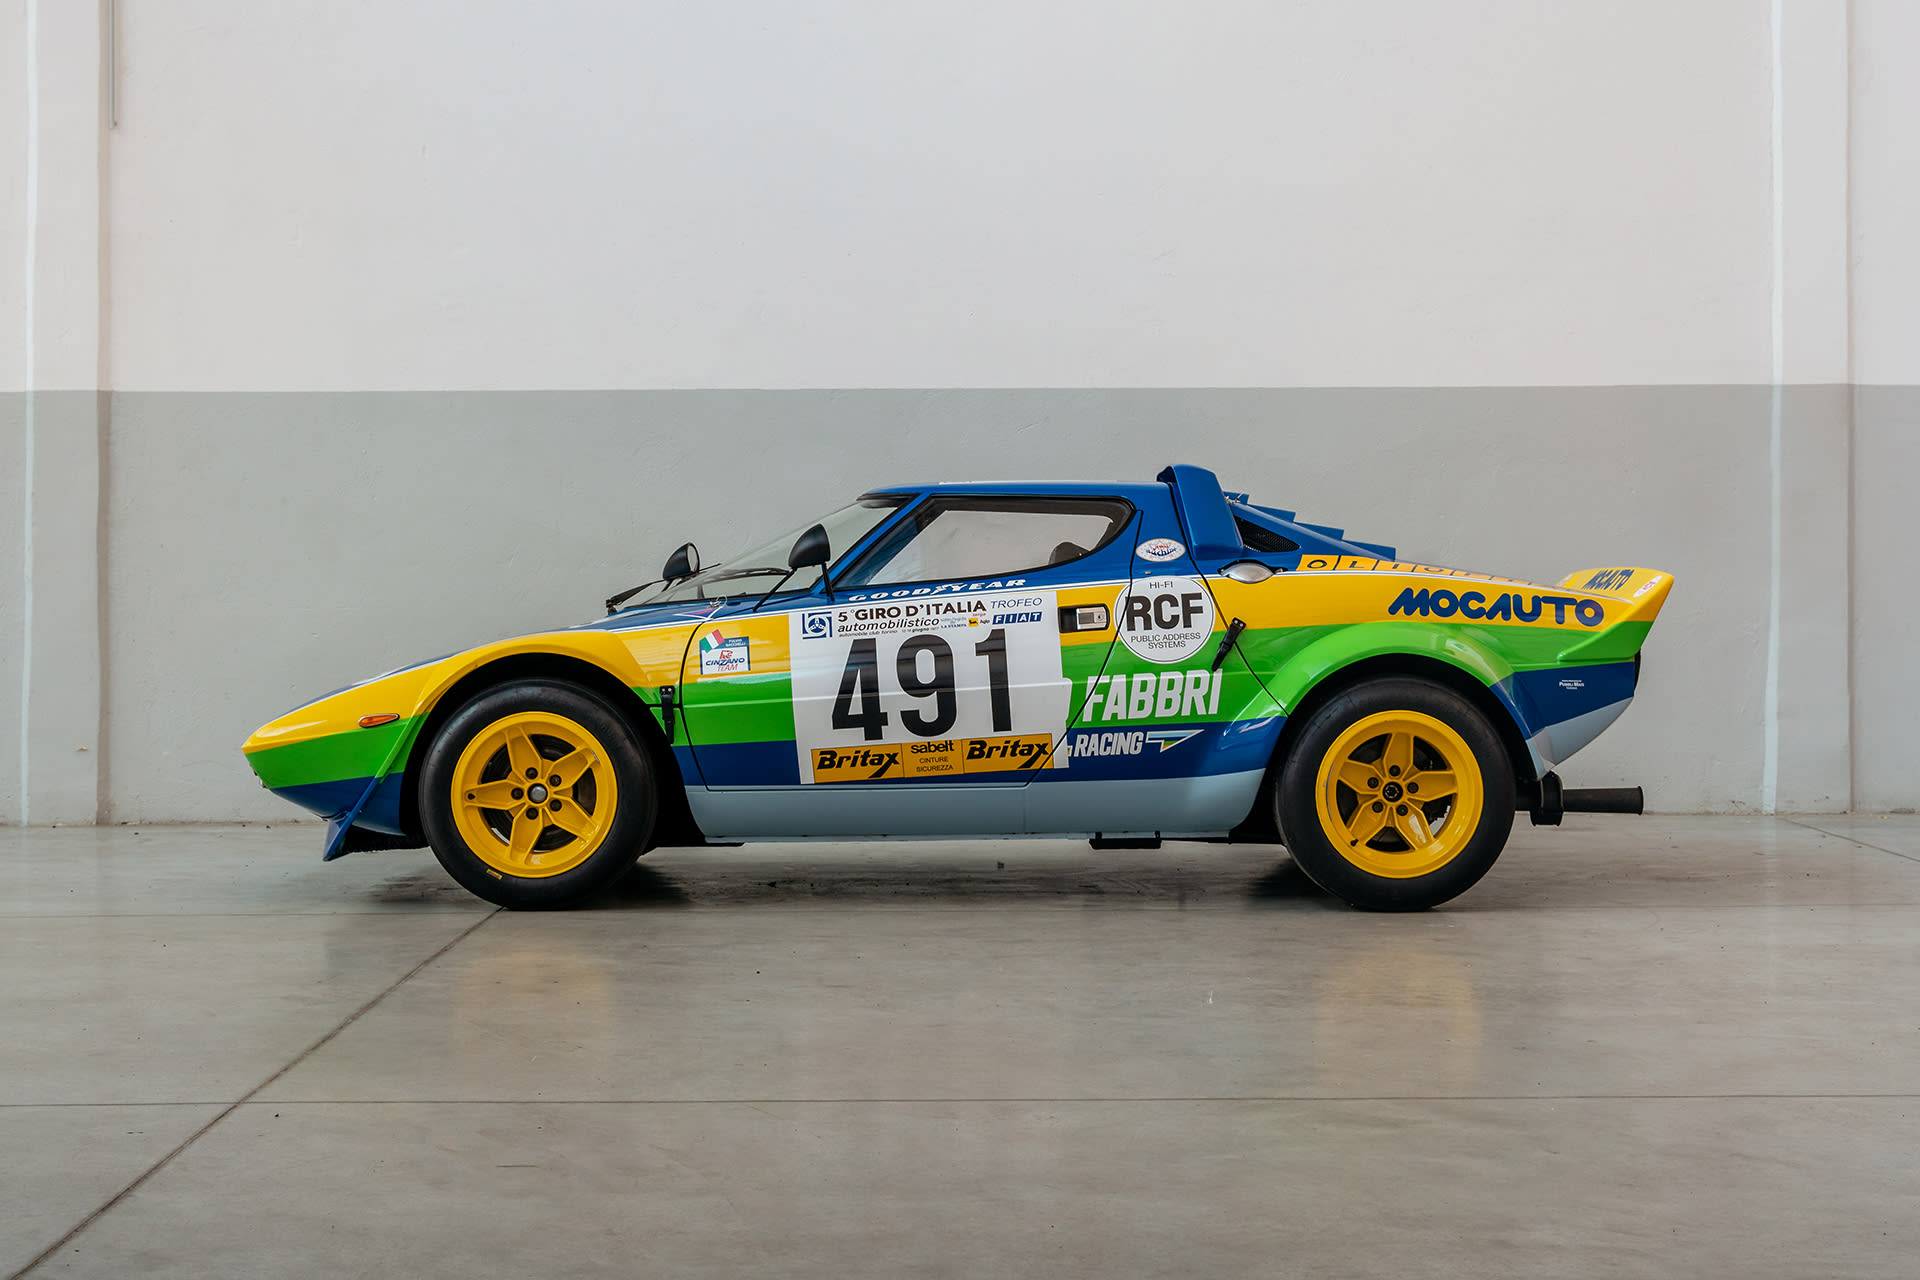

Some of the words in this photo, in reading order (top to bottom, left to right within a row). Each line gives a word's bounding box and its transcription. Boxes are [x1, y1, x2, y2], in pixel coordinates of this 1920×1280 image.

[849, 579, 1027, 602] GOODYEAR
[1149, 581, 1173, 589] HI-FI
[855, 606, 901, 621] GIRO
[905, 600, 987, 616] D'ITALIA
[991, 597, 1042, 609] TROFEO
[1125, 592, 1203, 631] RCF
[1388, 587, 1605, 627] MOCAUTO
[838, 616, 940, 633] automobilistico
[993, 611, 1042, 625] FIAT
[1131, 634, 1160, 643] PUBLIC
[1162, 632, 1201, 641] ADDRESS
[1148, 640, 1186, 649] SYSTEMS
[705, 657, 745, 666] CINZANO
[832, 628, 1012, 741] 491
[1082, 668, 1223, 722] FABBRI
[911, 740, 954, 753] sabelt
[1074, 731, 1144, 757] RACING
[817, 749, 899, 778] Britax
[966, 739, 1049, 769] Britax
[916, 764, 954, 773] SICUREZZA
